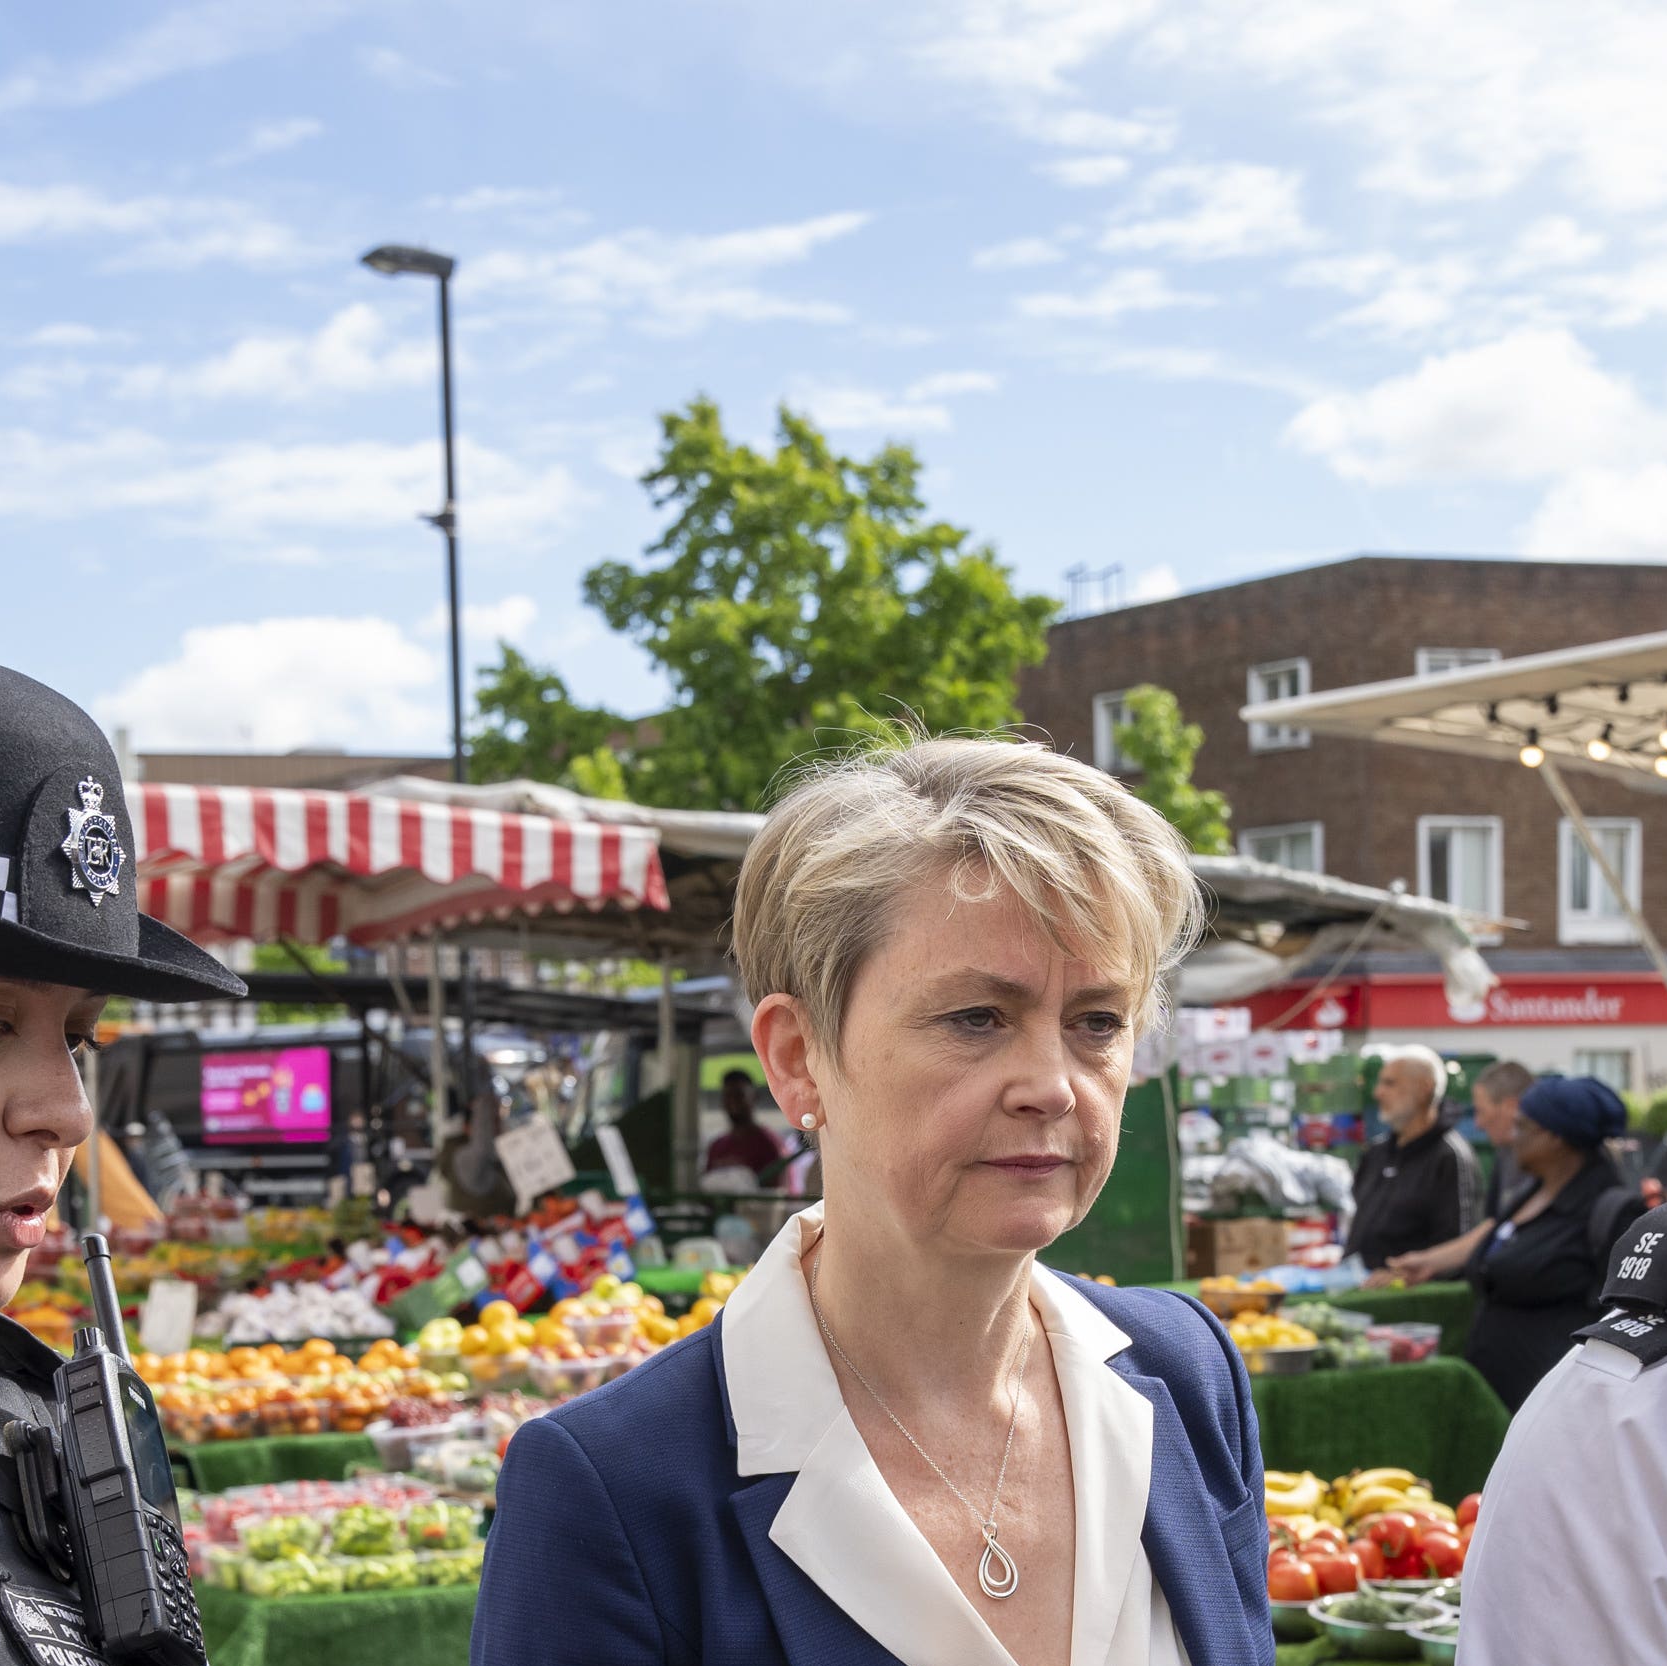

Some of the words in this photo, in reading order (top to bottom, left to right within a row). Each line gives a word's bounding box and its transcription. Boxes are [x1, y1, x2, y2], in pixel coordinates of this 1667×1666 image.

[1489, 988, 1623, 1021] Santander
[1634, 1232, 1664, 1254] SE
[1617, 1256, 1653, 1280] 1918
